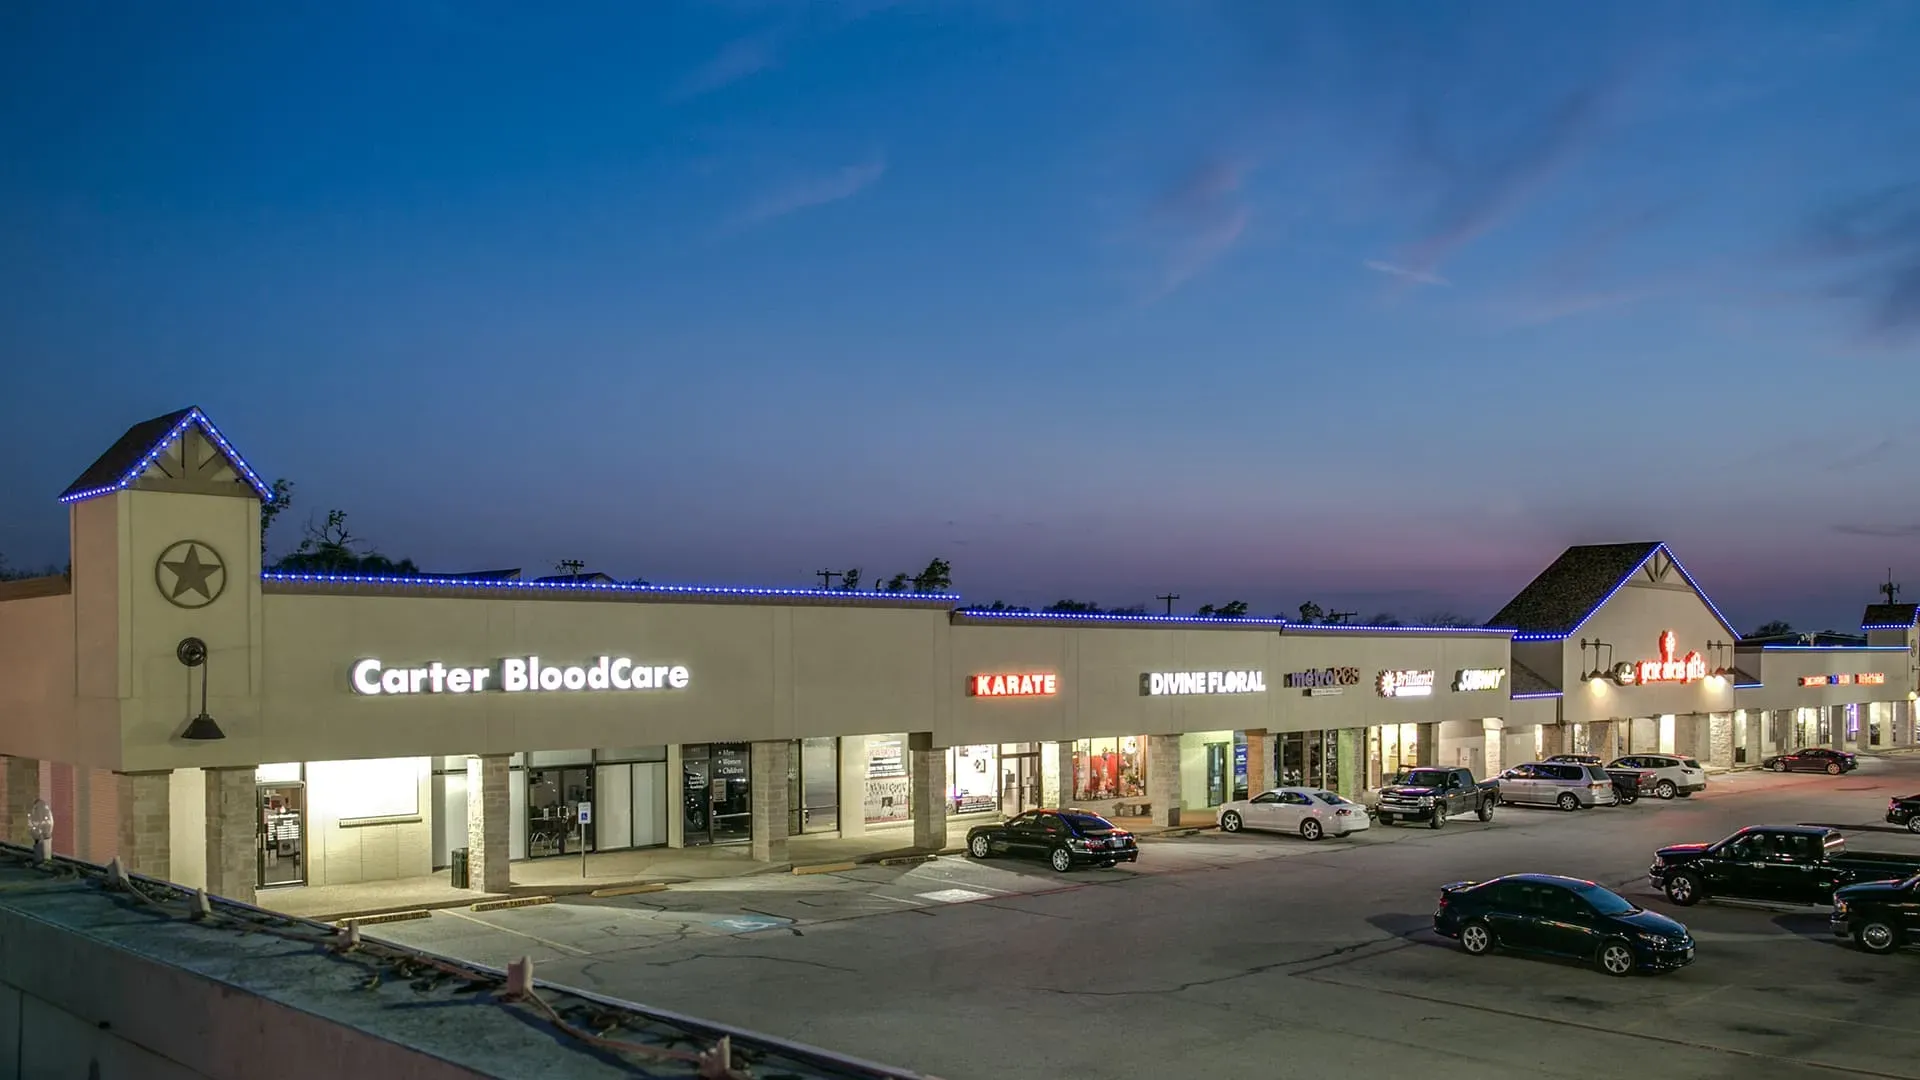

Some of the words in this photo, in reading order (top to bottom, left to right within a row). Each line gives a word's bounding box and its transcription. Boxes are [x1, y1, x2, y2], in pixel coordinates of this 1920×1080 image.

[353, 659, 489, 695] Carter
[503, 656, 689, 692] BloodCare
[976, 674, 1056, 697] KARATE
[1150, 671, 1206, 696] DIVINE
[1207, 670, 1266, 693] FLORAL
[1459, 668, 1505, 691] SUBWAY
[722, 767, 744, 775] Children
